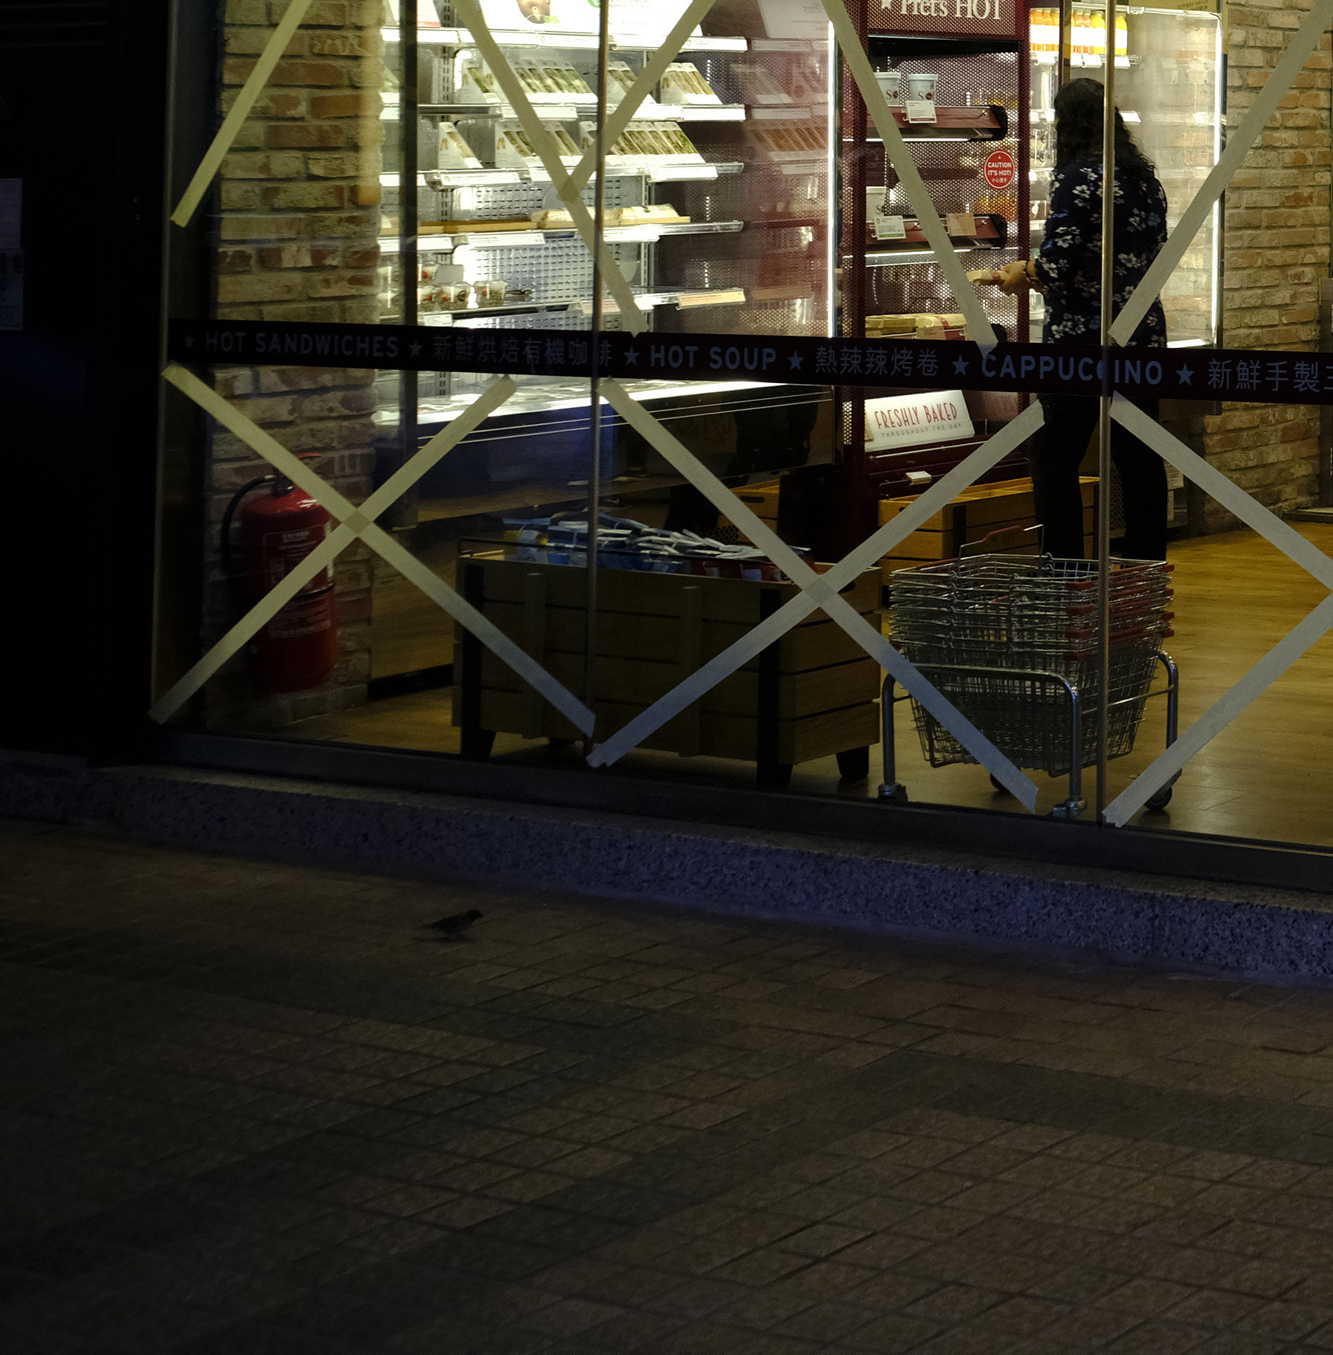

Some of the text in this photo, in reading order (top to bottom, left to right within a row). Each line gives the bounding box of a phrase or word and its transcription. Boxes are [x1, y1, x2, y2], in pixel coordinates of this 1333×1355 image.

[204, 331, 399, 359] HOT SANDWICHES
[649, 345, 777, 372] HOT SOUP
[815, 345, 940, 378] 熱辣辣烤卷
[874, 402, 957, 429] FRESHLY BAKED
[881, 427, 929, 438] THROUGHOUT
